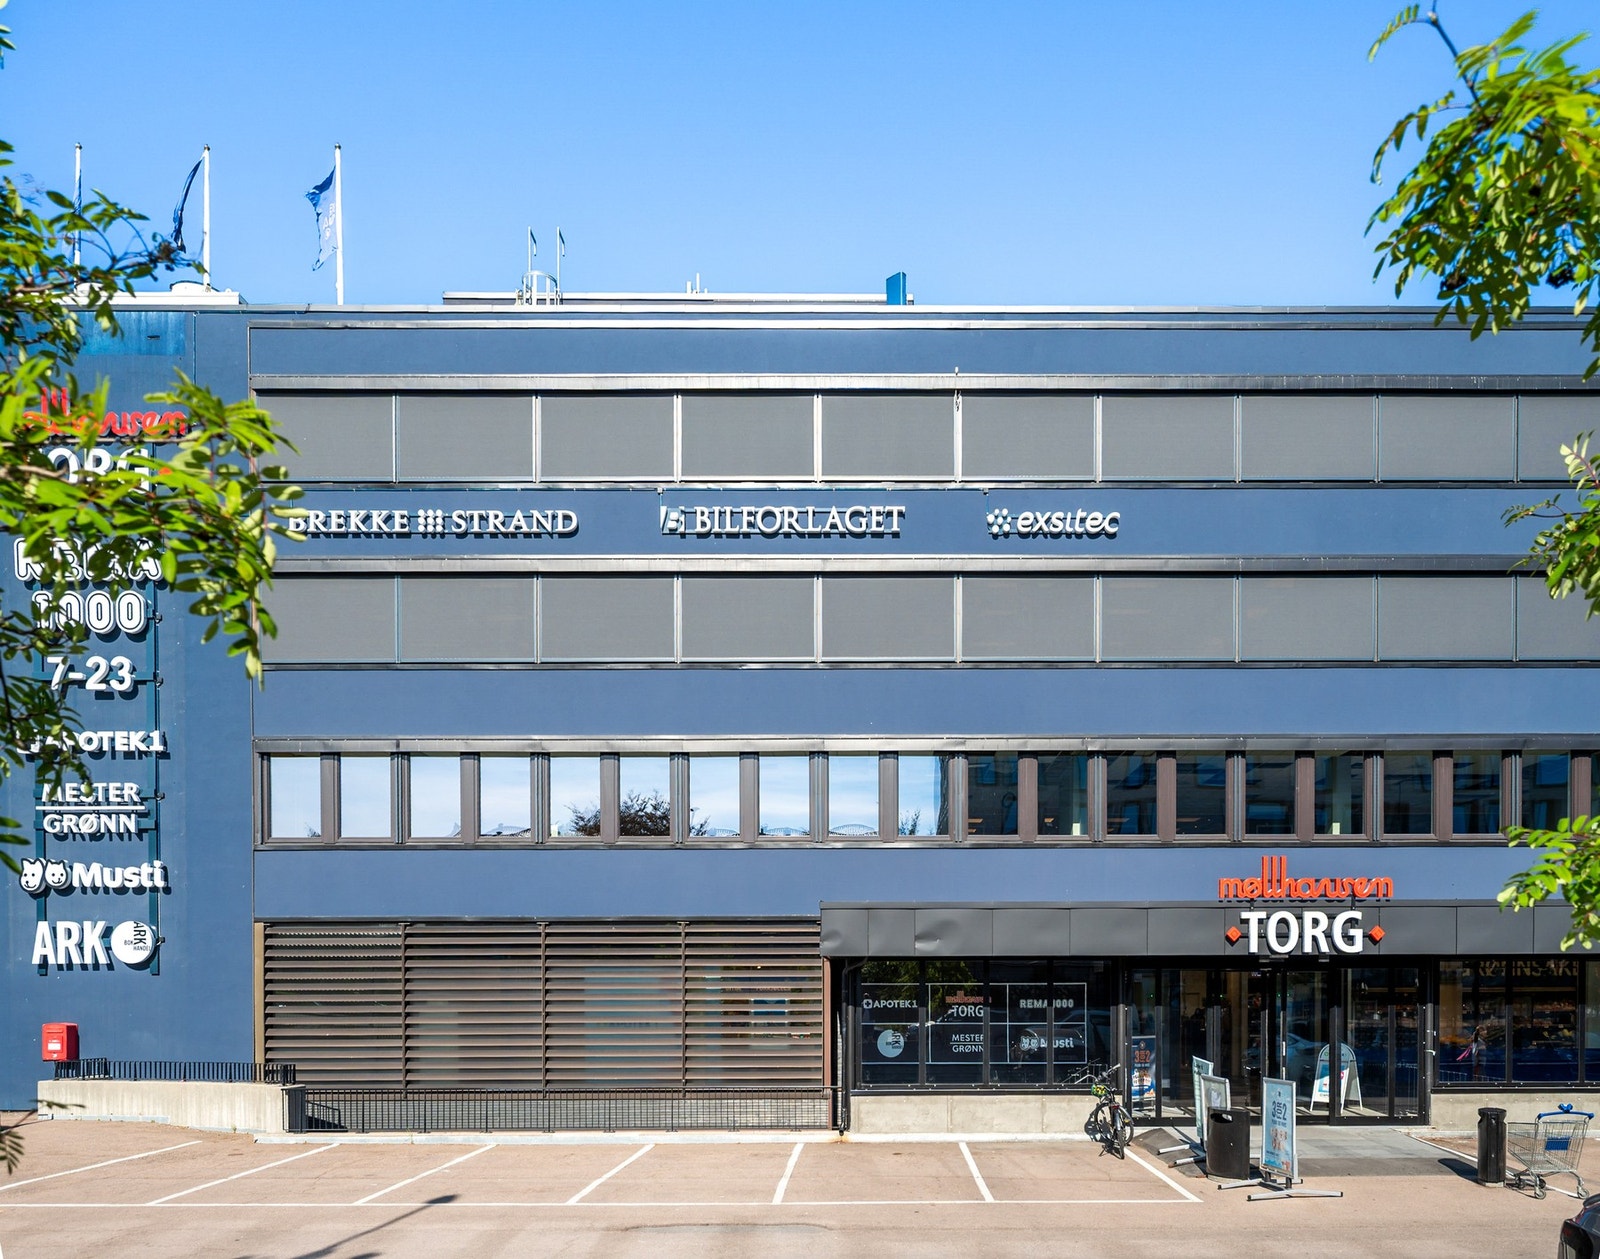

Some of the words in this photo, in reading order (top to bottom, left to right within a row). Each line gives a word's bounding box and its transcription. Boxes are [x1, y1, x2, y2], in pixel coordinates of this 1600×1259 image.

[288, 509, 410, 533] BREKKE
[451, 509, 579, 534] STRAND
[694, 505, 906, 534] BILFORLAGET
[1016, 508, 1121, 534] exsitec
[47, 656, 135, 690] 7-23
[41, 782, 140, 802] MESTER
[43, 813, 138, 834] GRØNN
[72, 861, 166, 888] Musti
[31, 920, 110, 965] ARK
[1240, 910, 1364, 954] TORG
[873, 999, 918, 1008] APOTEK1
[952, 1005, 984, 1017] TORG
